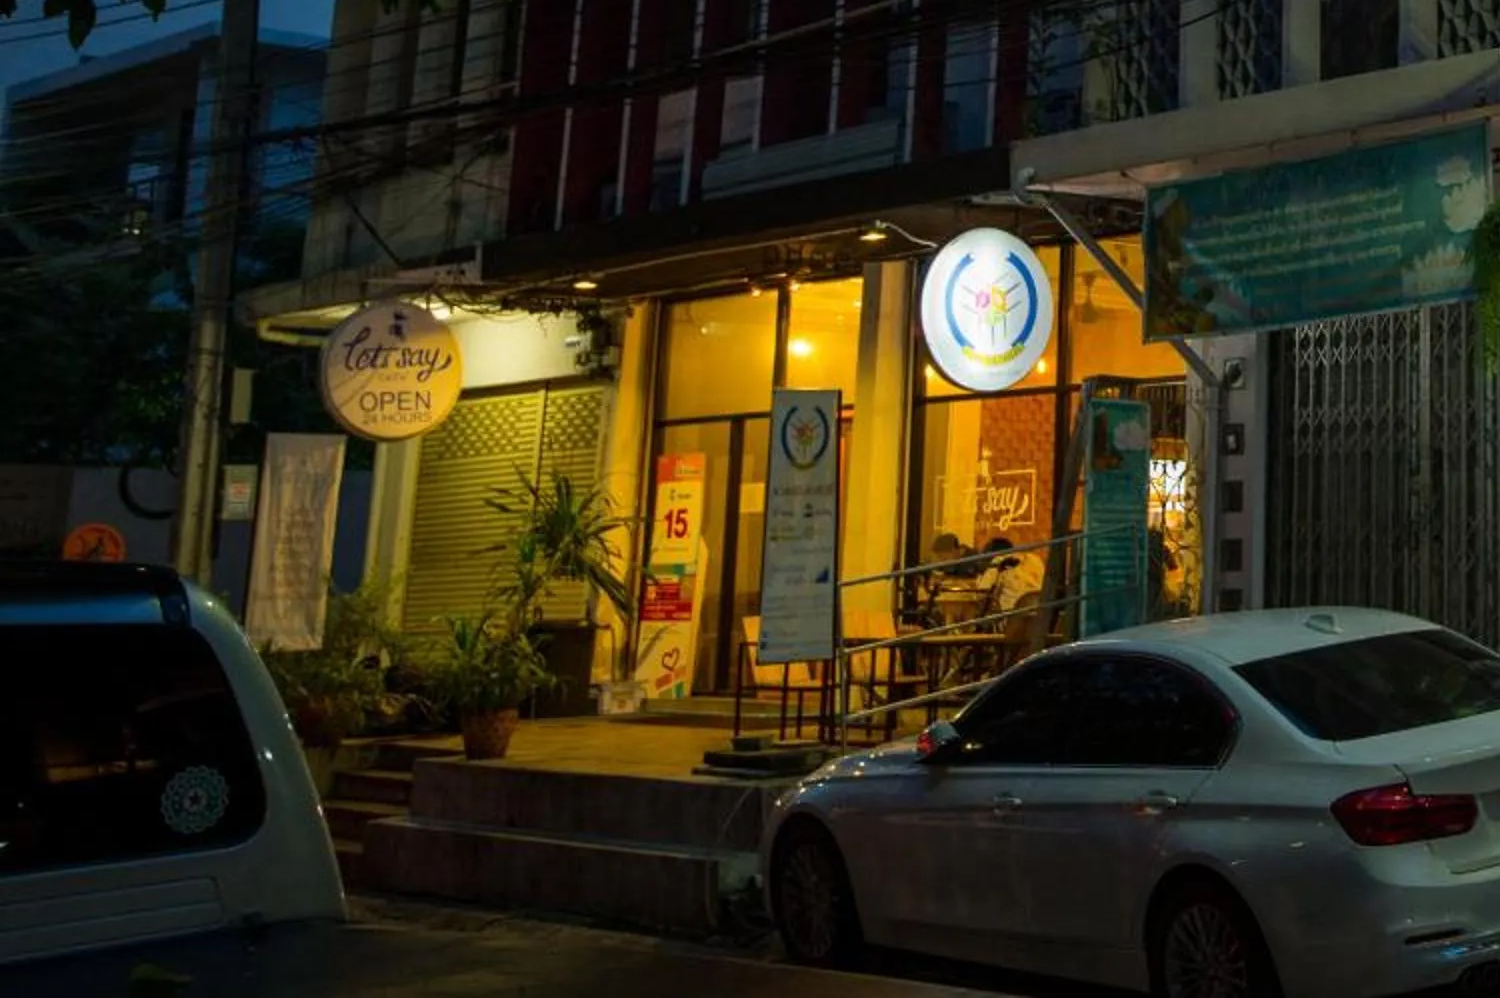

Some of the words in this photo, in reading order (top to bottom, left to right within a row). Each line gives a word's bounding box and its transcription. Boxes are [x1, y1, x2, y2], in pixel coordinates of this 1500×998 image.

[358, 389, 432, 412] OPEN
[381, 410, 433, 424] HOURS
[663, 506, 689, 539] 15
